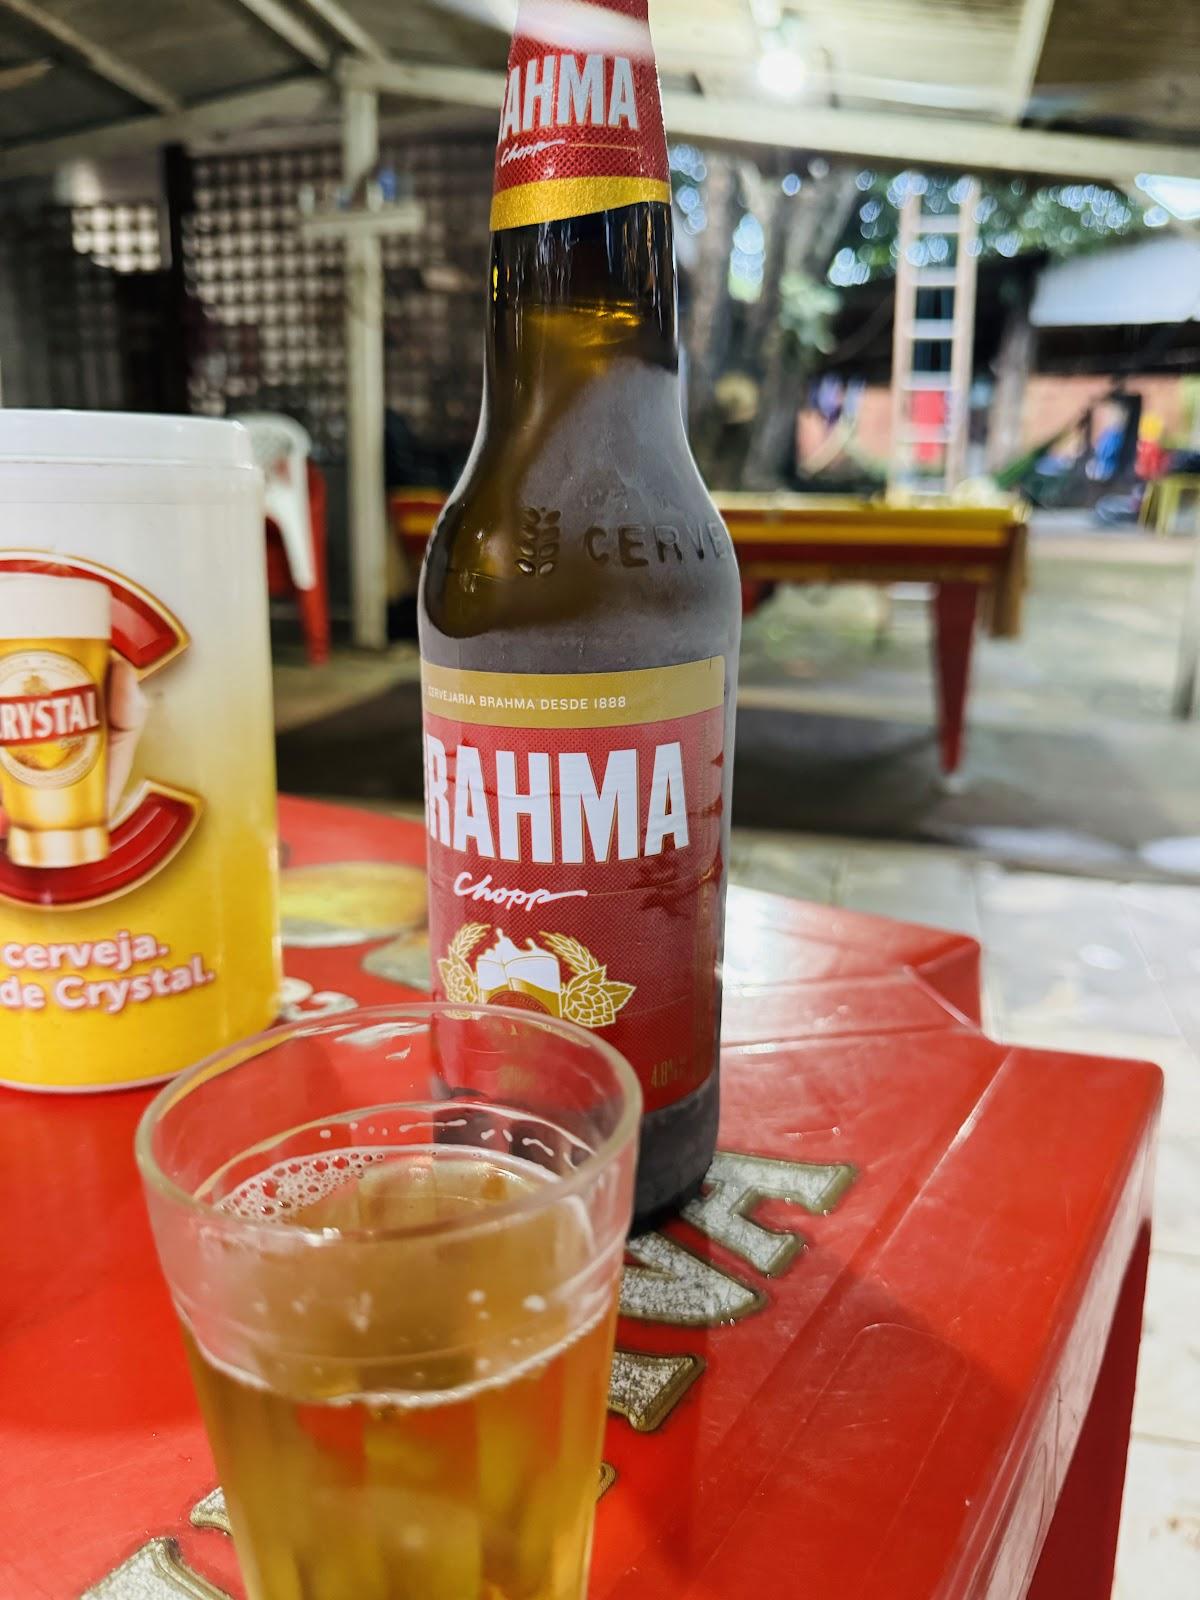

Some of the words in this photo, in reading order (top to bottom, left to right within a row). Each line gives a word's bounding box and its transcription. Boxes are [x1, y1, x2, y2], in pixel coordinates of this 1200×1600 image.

[499, 54, 640, 146] AHMA
[501, 138, 566, 167] Chopp
[0, 691, 101, 742] RYSTAL
[480, 695, 535, 709] BRAHMA
[540, 698, 589, 711] DESDE
[594, 696, 627, 709] 1888
[424, 733, 690, 865] RAHMA
[453, 871, 588, 911] Chopp
[2, 929, 170, 972] cerveja.
[54, 953, 216, 1015] Crystal.
